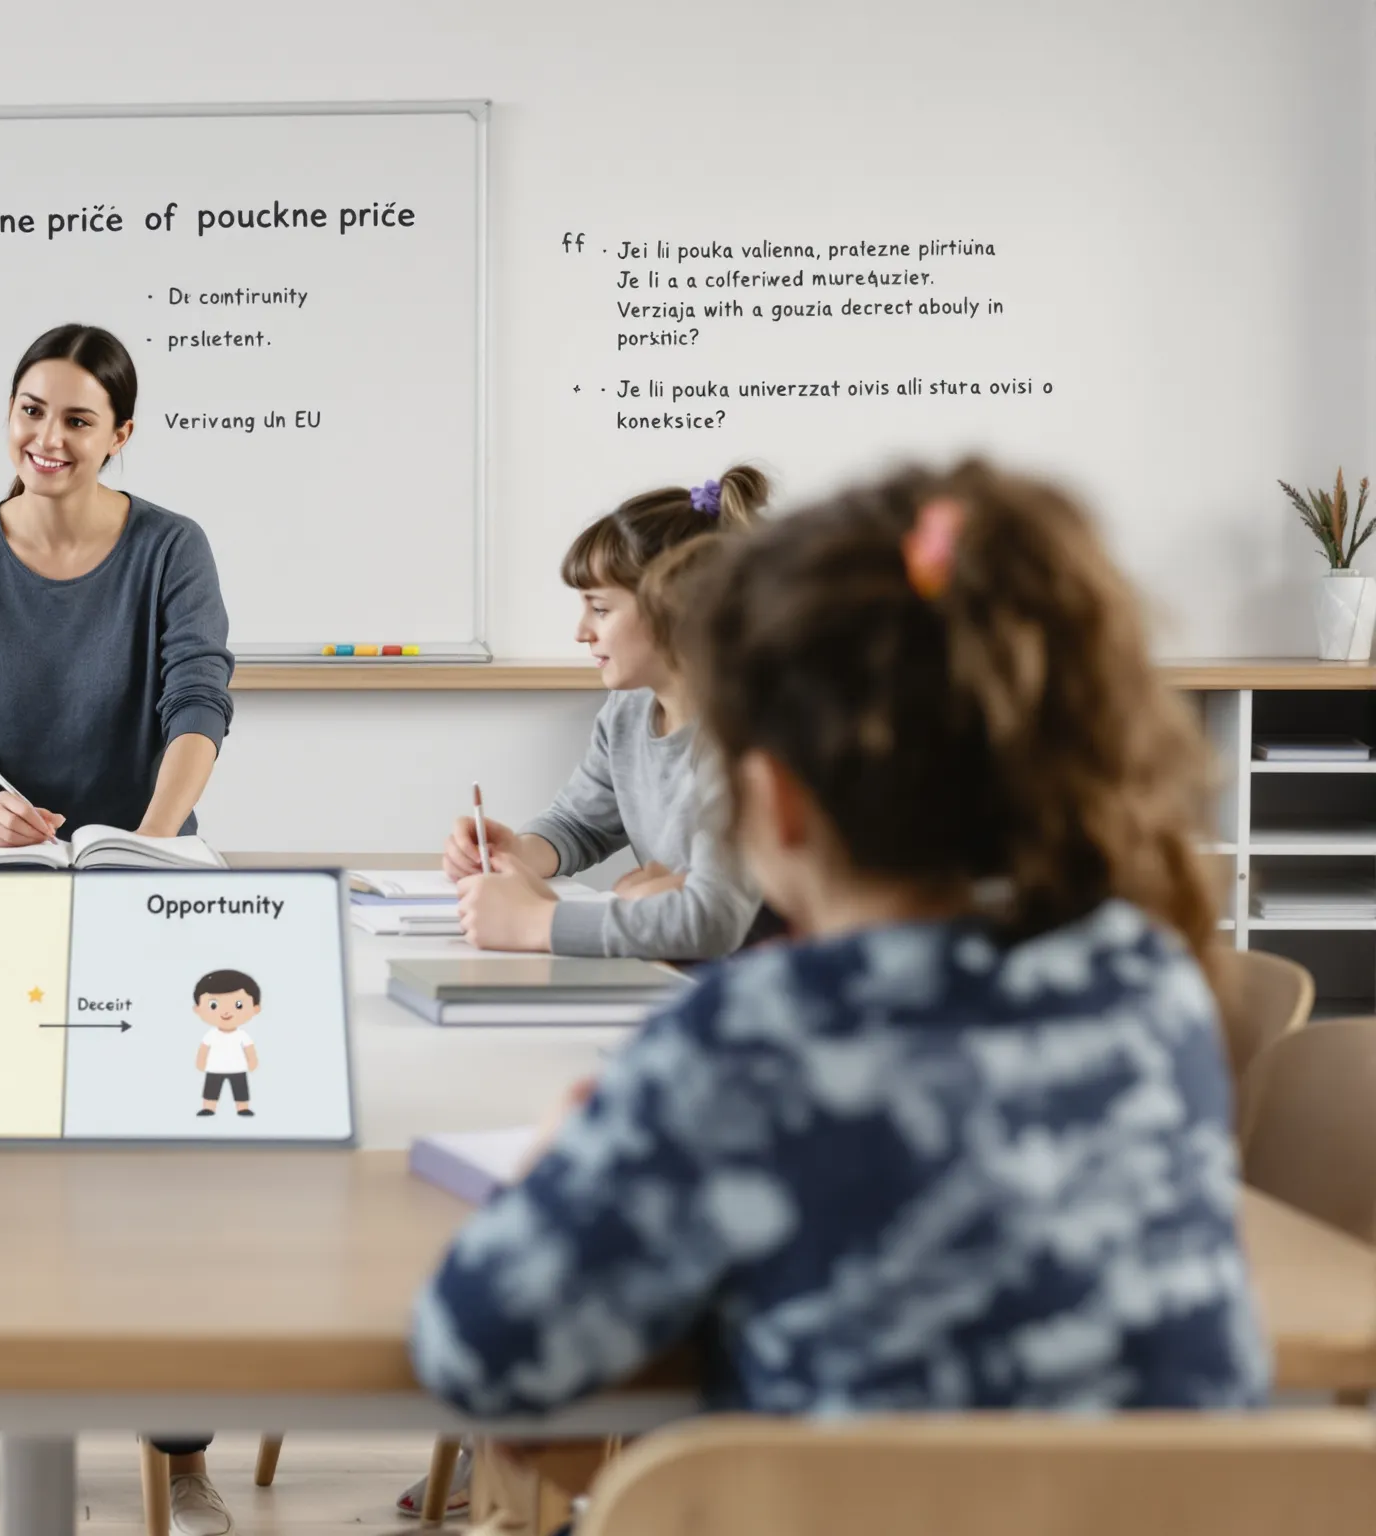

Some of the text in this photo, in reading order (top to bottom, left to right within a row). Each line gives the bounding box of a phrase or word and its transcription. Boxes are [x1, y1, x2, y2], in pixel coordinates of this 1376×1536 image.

[144, 201, 178, 232] of
[197, 199, 328, 237] pouckne
[677, 240, 734, 264] pouka
[741, 239, 821, 261] valienna,
[616, 270, 640, 289] Je
[648, 270, 659, 289] li
[667, 276, 679, 289] a
[686, 276, 698, 289] a
[616, 296, 1004, 324] Verziaja with a gouzia decrect abouly in
[616, 379, 641, 399] Je
[672, 380, 730, 404] pouka
[738, 380, 841, 397] univerzzat
[847, 379, 890, 397] oivis
[896, 376, 923, 396] alli
[989, 377, 1032, 395] ovisi
[164, 412, 255, 434] Verivang
[295, 410, 321, 429] EU
[146, 893, 285, 920] Opportunity
